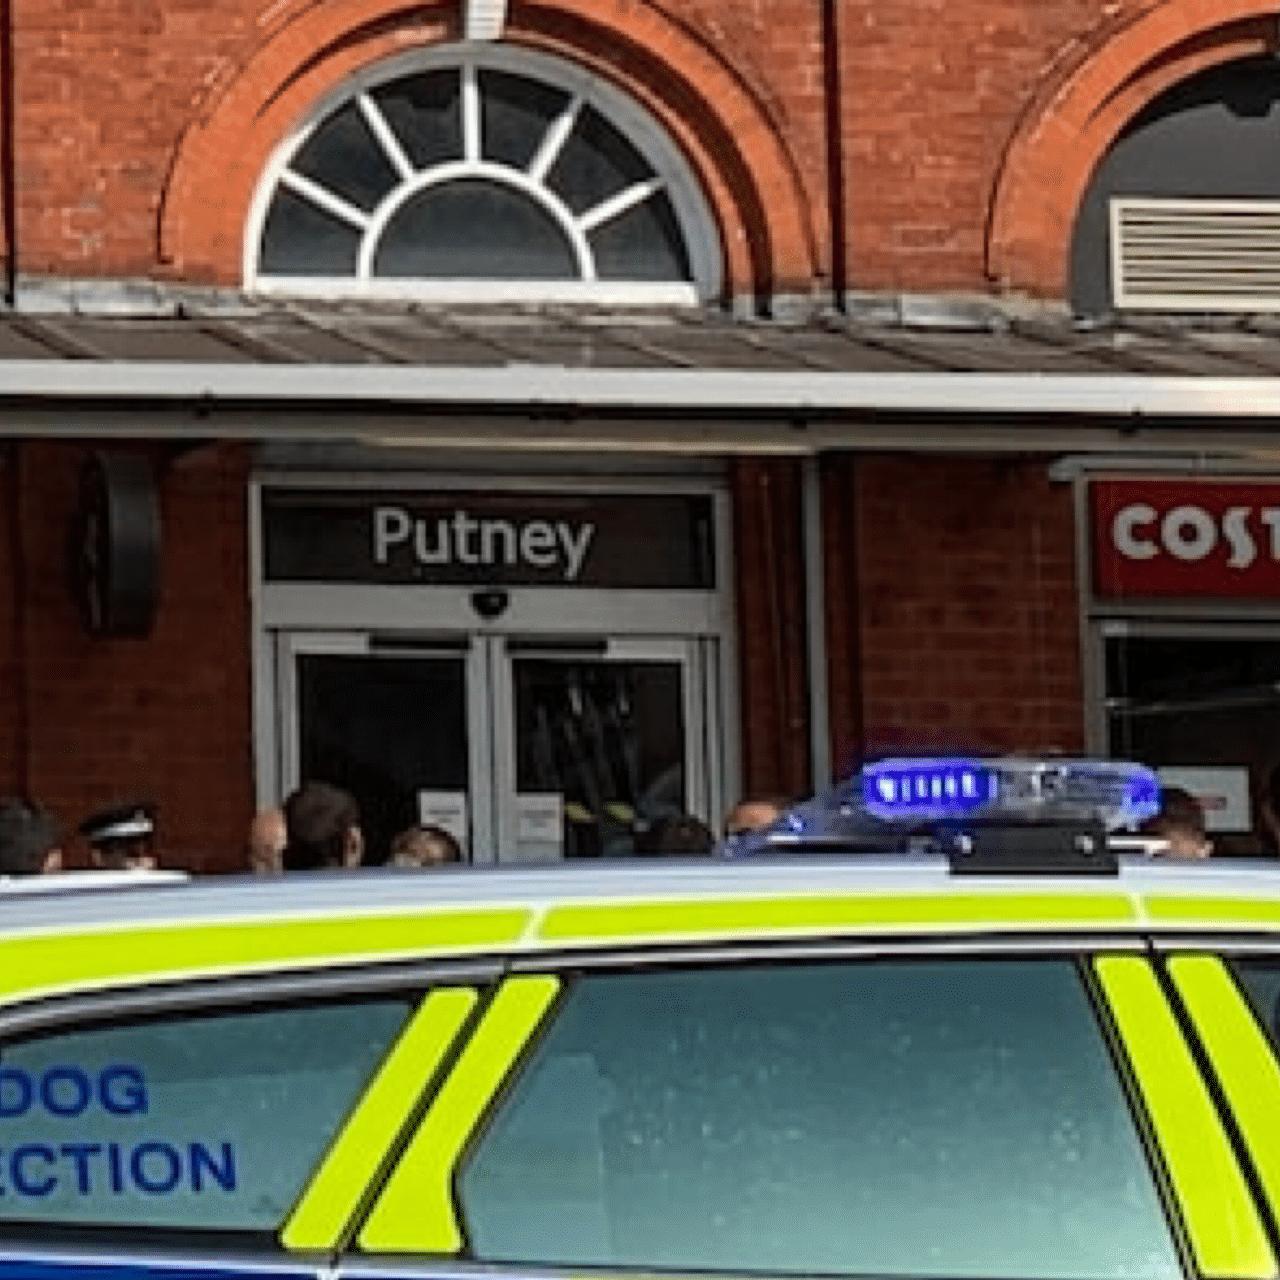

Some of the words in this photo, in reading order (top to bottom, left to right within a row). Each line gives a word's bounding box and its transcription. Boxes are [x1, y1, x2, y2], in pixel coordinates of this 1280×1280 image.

[373, 507, 597, 581] Putney
[0, 1064, 149, 1118] DOG
[0, 1141, 237, 1198] CTION
